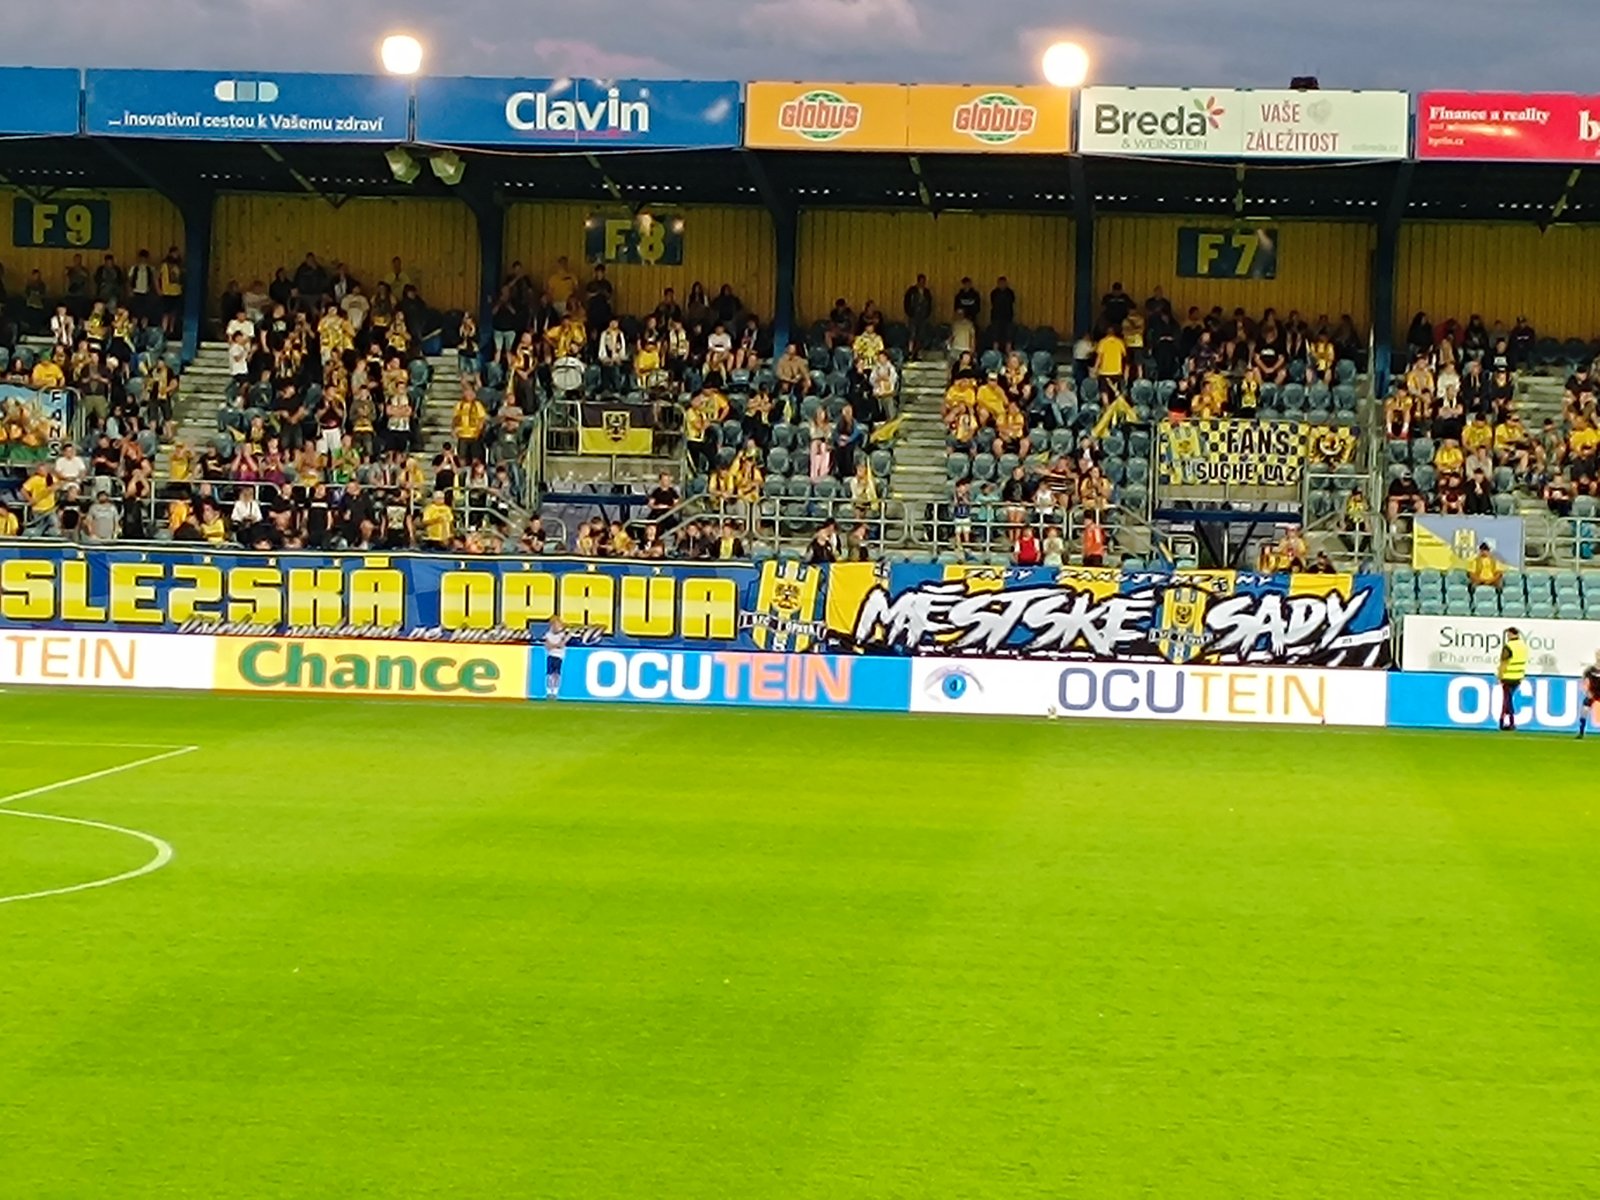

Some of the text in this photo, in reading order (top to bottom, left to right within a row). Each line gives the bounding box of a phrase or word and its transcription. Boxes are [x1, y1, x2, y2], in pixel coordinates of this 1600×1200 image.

[203, 114, 254, 128] cestou
[258, 113, 268, 129] k
[269, 113, 333, 131] Vašemu
[335, 115, 384, 131] zdraví
[506, 88, 650, 132] Clavin
[1094, 103, 1208, 137] Breda
[1260, 99, 1301, 124] VAŠE
[1429, 106, 1551, 124] Finance a reality
[1134, 139, 1208, 150] WEINSTEIN
[1246, 129, 1339, 152] ZÁLEŽITOST
[1226, 427, 1291, 456] FANS
[1206, 588, 1373, 660] SADY
[5, 634, 136, 680] TEIN
[238, 640, 500, 695] Chance
[586, 650, 852, 703] OCUTEIN
[1058, 667, 1326, 718] OCUTEIN
